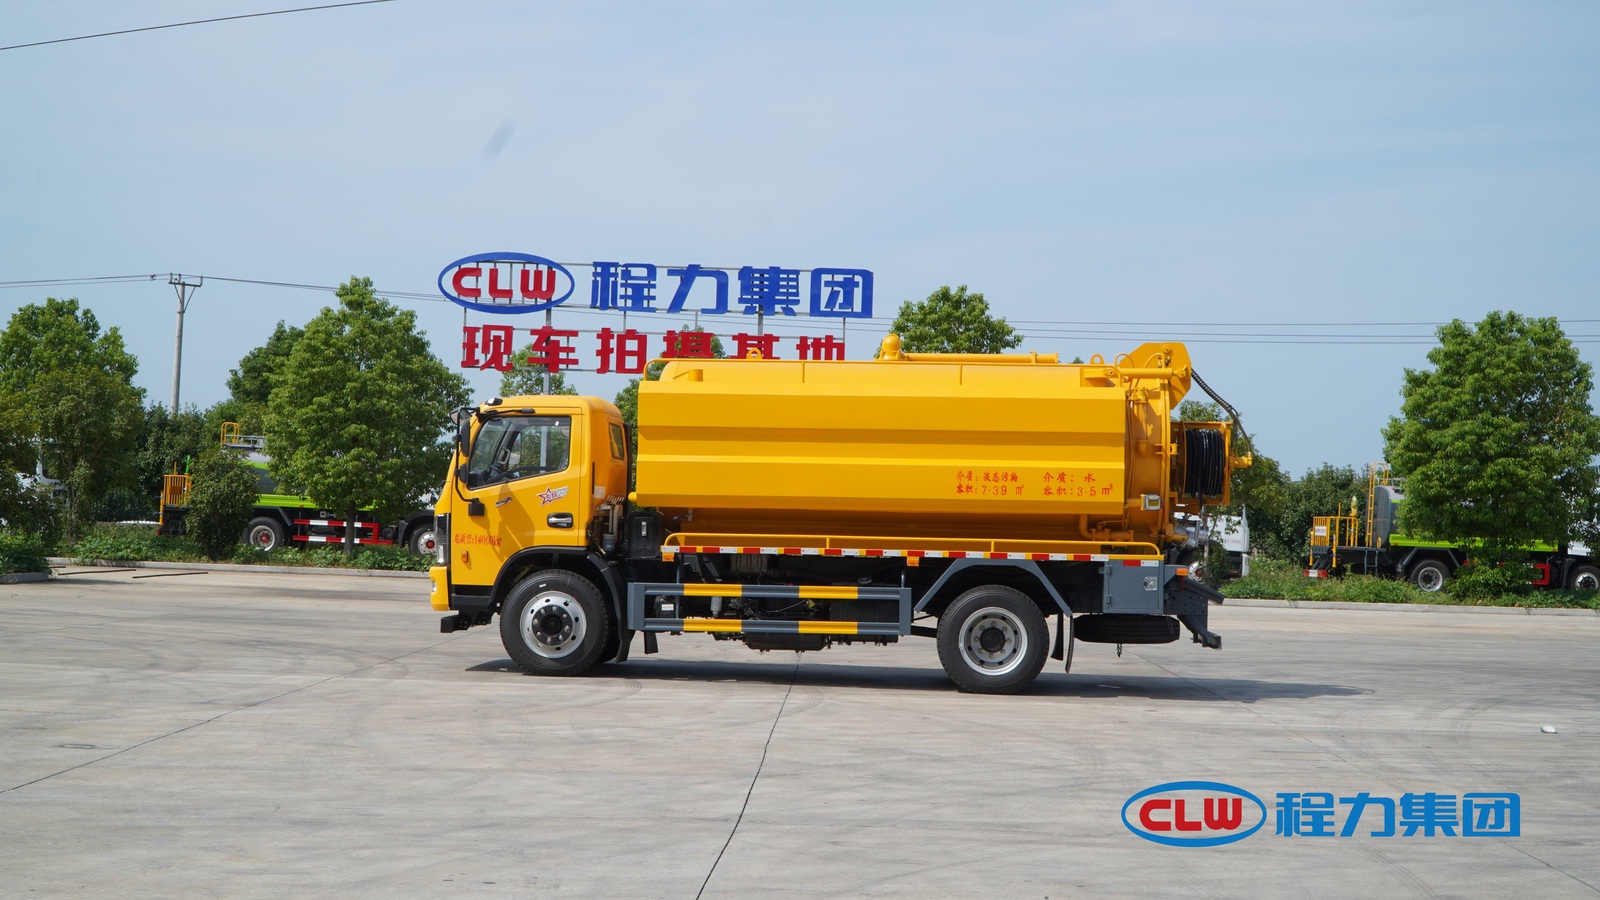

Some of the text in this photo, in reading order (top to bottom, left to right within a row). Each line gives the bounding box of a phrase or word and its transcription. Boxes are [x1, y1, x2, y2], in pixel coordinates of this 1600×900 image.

[452, 267, 556, 300] CLW
[590, 261, 874, 318] 程力集团
